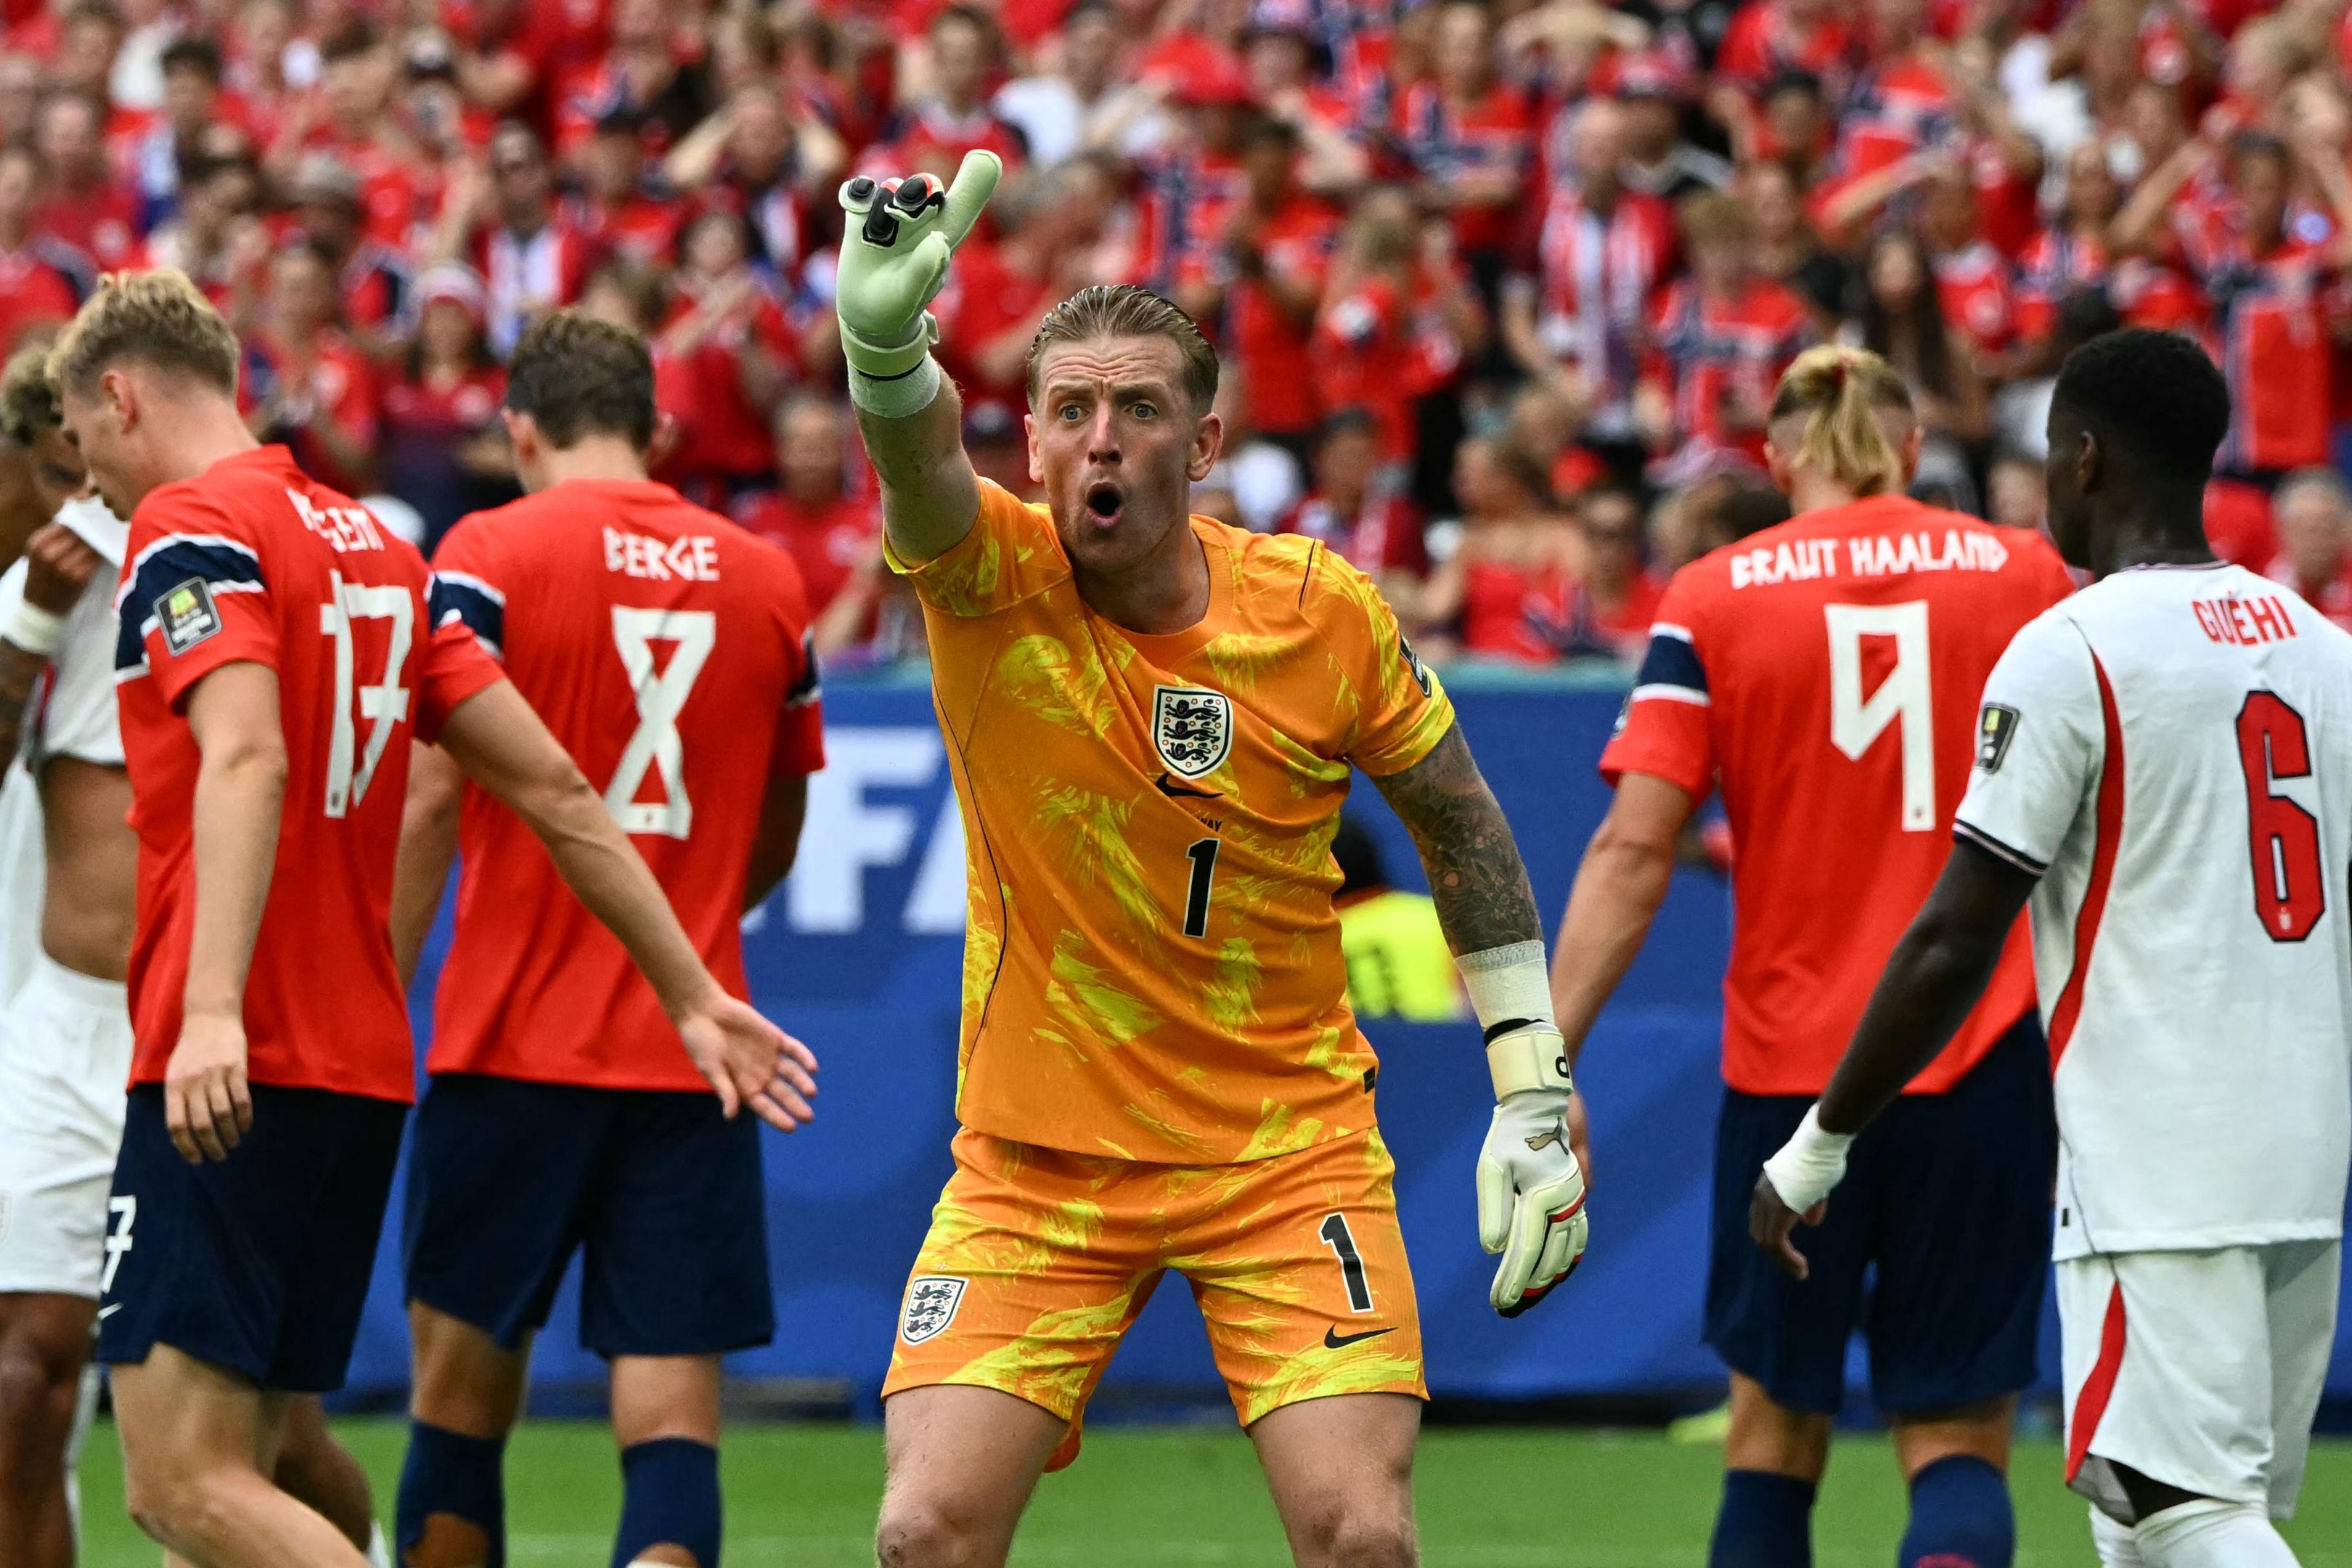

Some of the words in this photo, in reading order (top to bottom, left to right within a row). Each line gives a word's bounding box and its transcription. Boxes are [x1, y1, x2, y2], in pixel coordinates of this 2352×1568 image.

[603, 526, 719, 581] BERGE
[1731, 538, 1839, 589] BRAUT
[1848, 529, 2009, 577] HAALAND
[320, 568, 413, 819] 17
[604, 603, 715, 840] 8
[1824, 600, 1935, 831] 9
[1182, 838, 1220, 939] 1
[2236, 690, 2325, 942] 6
[1318, 1211, 1374, 1314] 1
